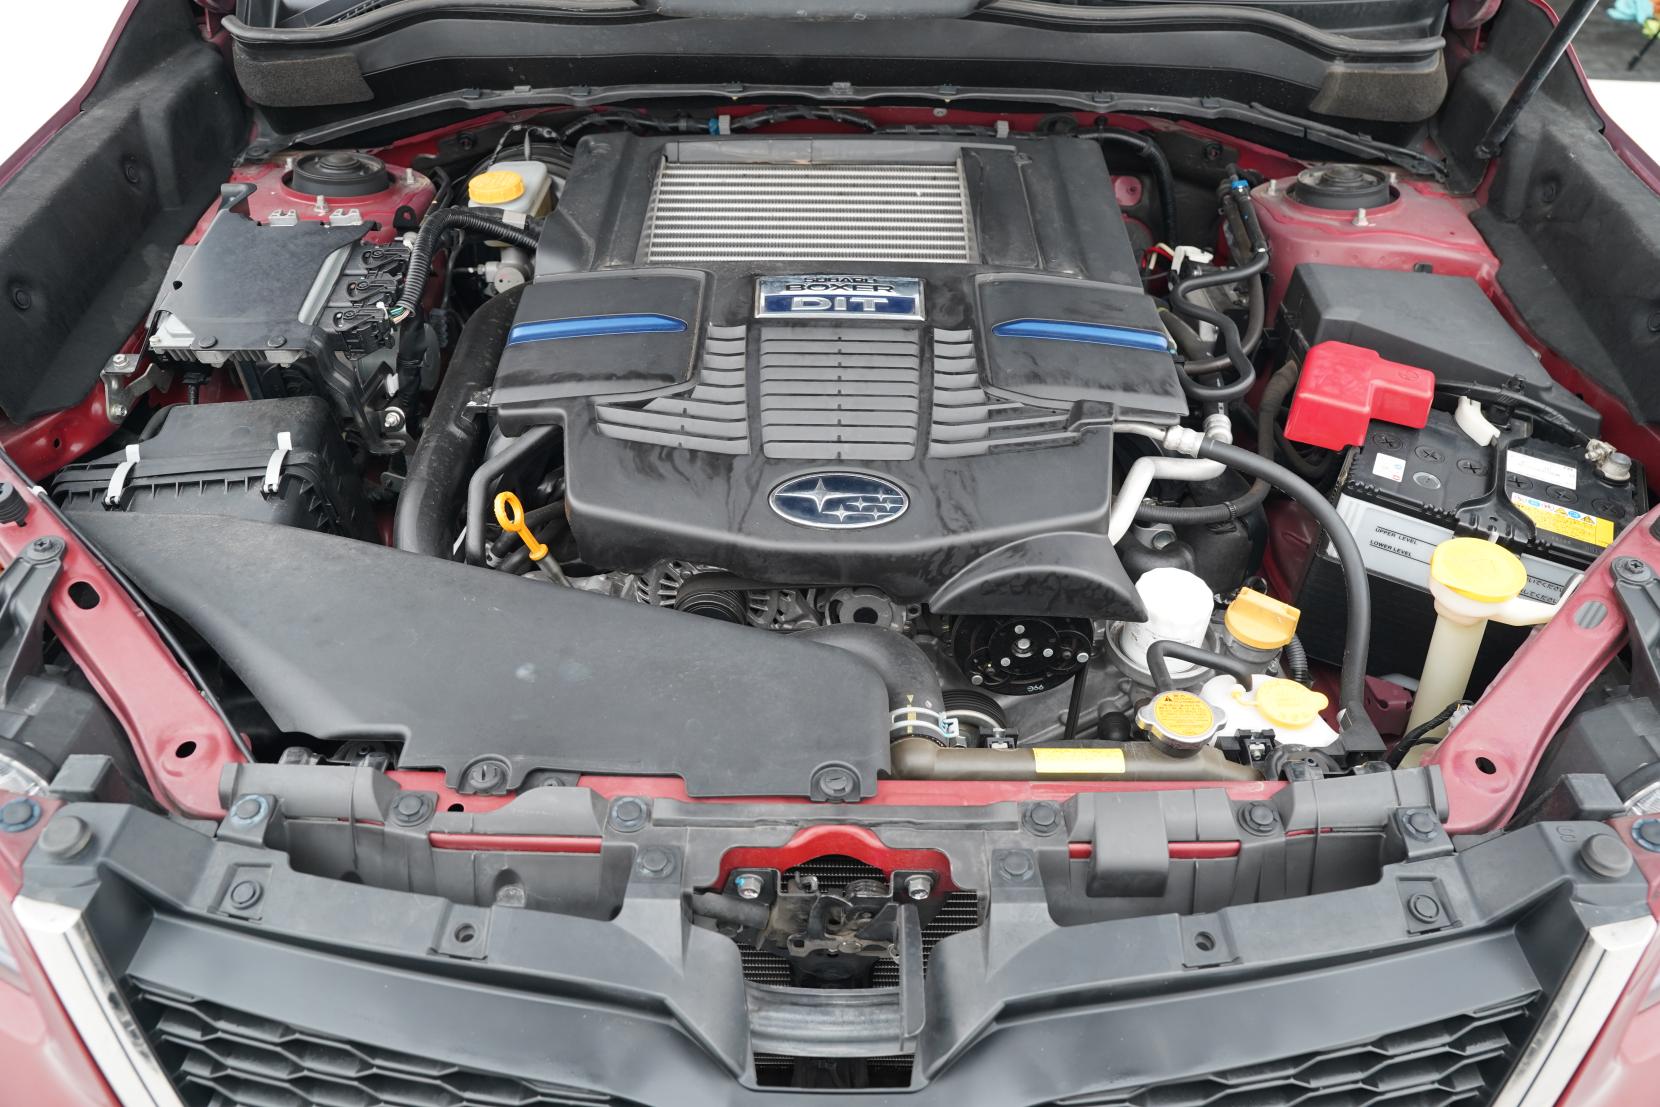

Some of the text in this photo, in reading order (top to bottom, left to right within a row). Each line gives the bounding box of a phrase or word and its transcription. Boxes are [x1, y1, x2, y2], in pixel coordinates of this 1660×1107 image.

[786, 284, 894, 293] BOXER
[791, 296, 888, 311] DIT
[1375, 527, 1418, 545] UPPER LEVEL
[1370, 540, 1412, 557] LOWER LEVEL
